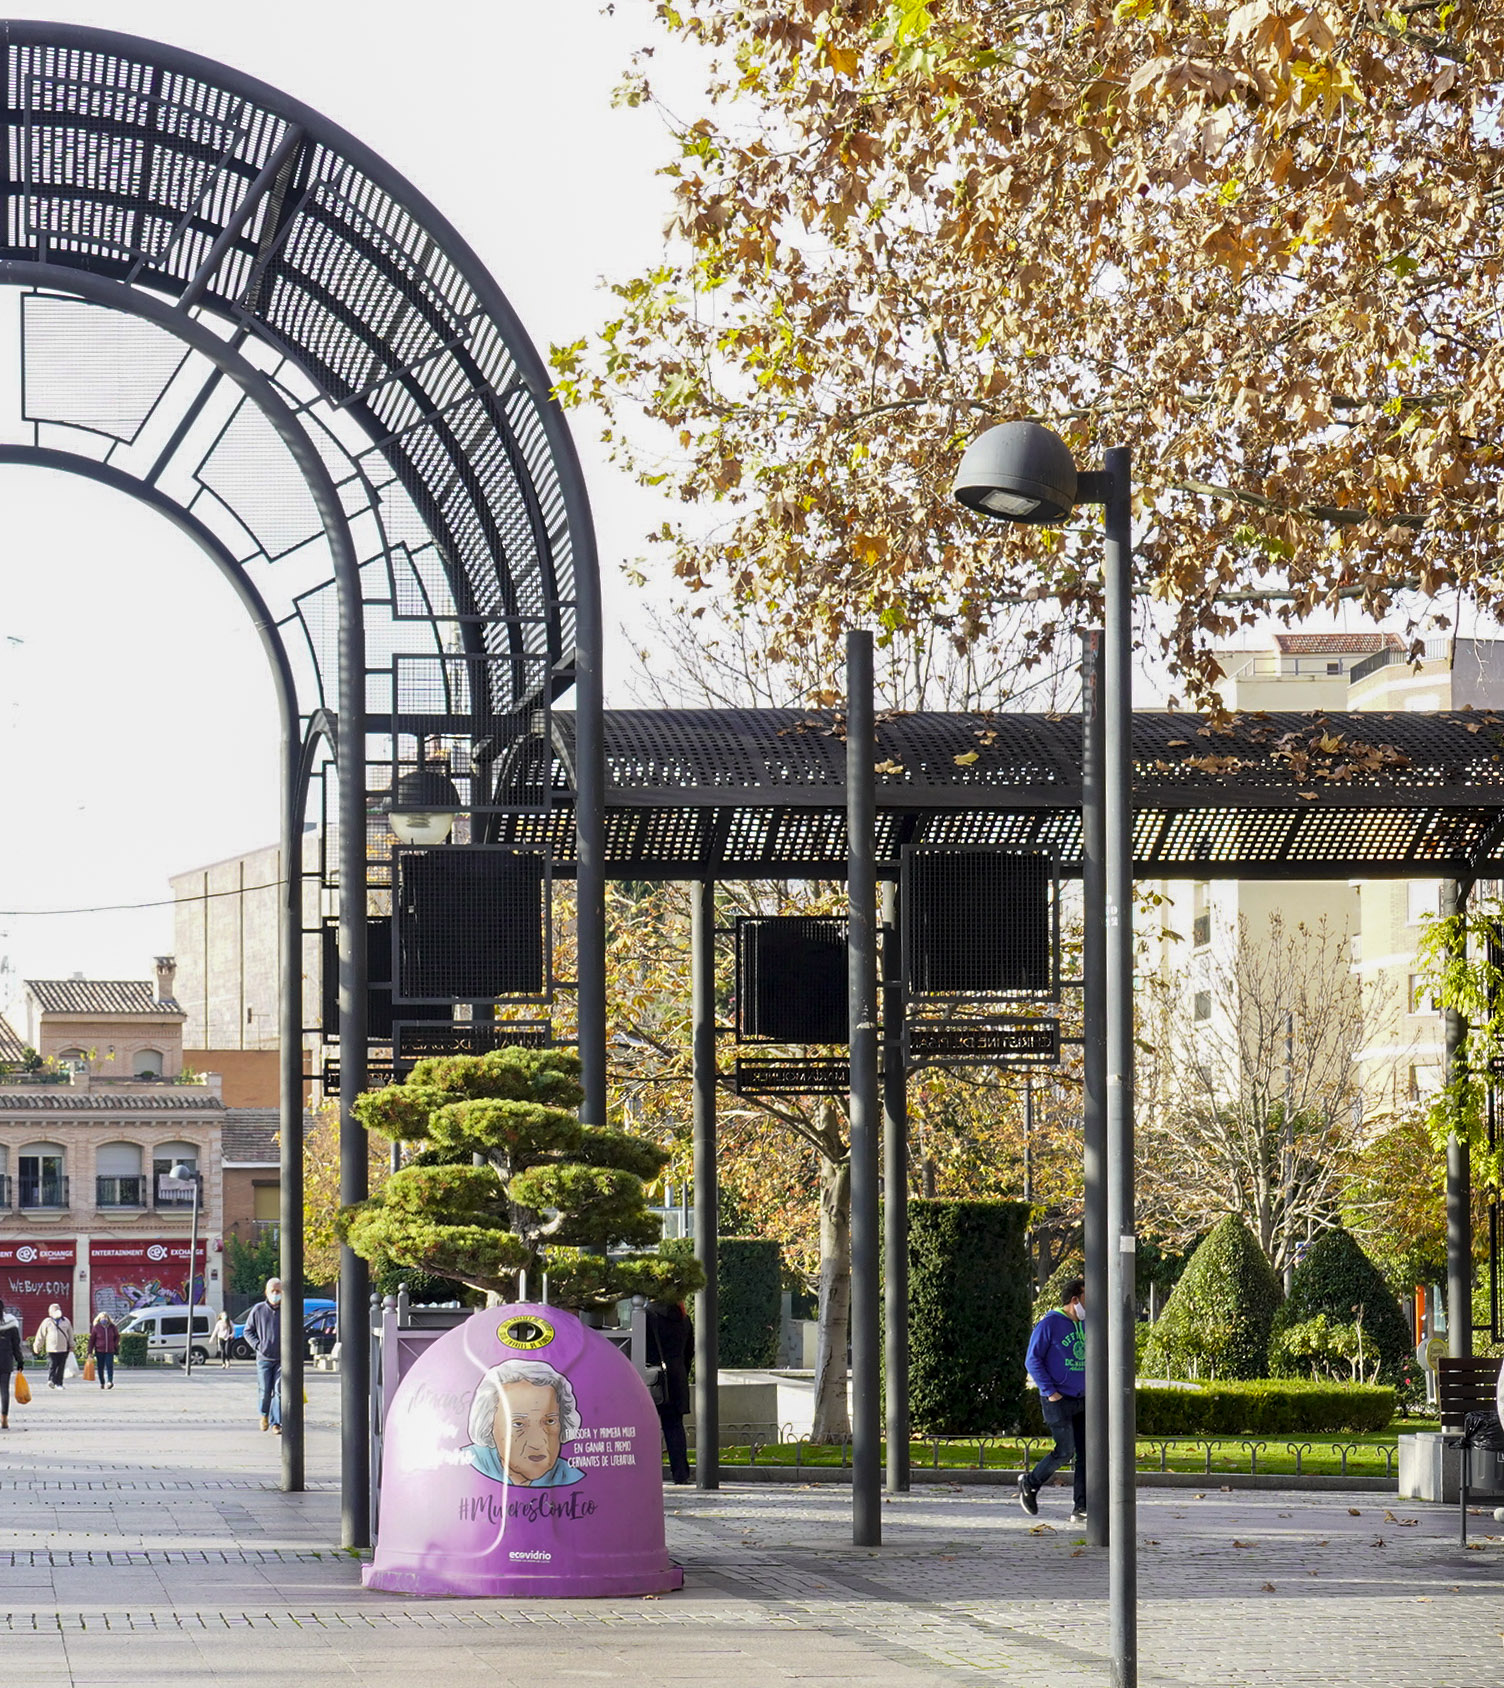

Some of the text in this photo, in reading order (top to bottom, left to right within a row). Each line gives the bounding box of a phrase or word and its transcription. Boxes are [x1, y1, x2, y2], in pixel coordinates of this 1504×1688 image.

[91, 1249, 144, 1257] ENTERTAINMENT
[170, 1248, 204, 1256] EXCHAGE
[592, 1428, 598, 1439] Y
[599, 1426, 621, 1439] PRIMERA
[573, 1440, 632, 1454] EN GANAR EL PREMIO
[567, 1454, 600, 1468] CERVANTES
[601, 1455, 609, 1467] DE
[509, 1550, 552, 1560] ecovidrio
